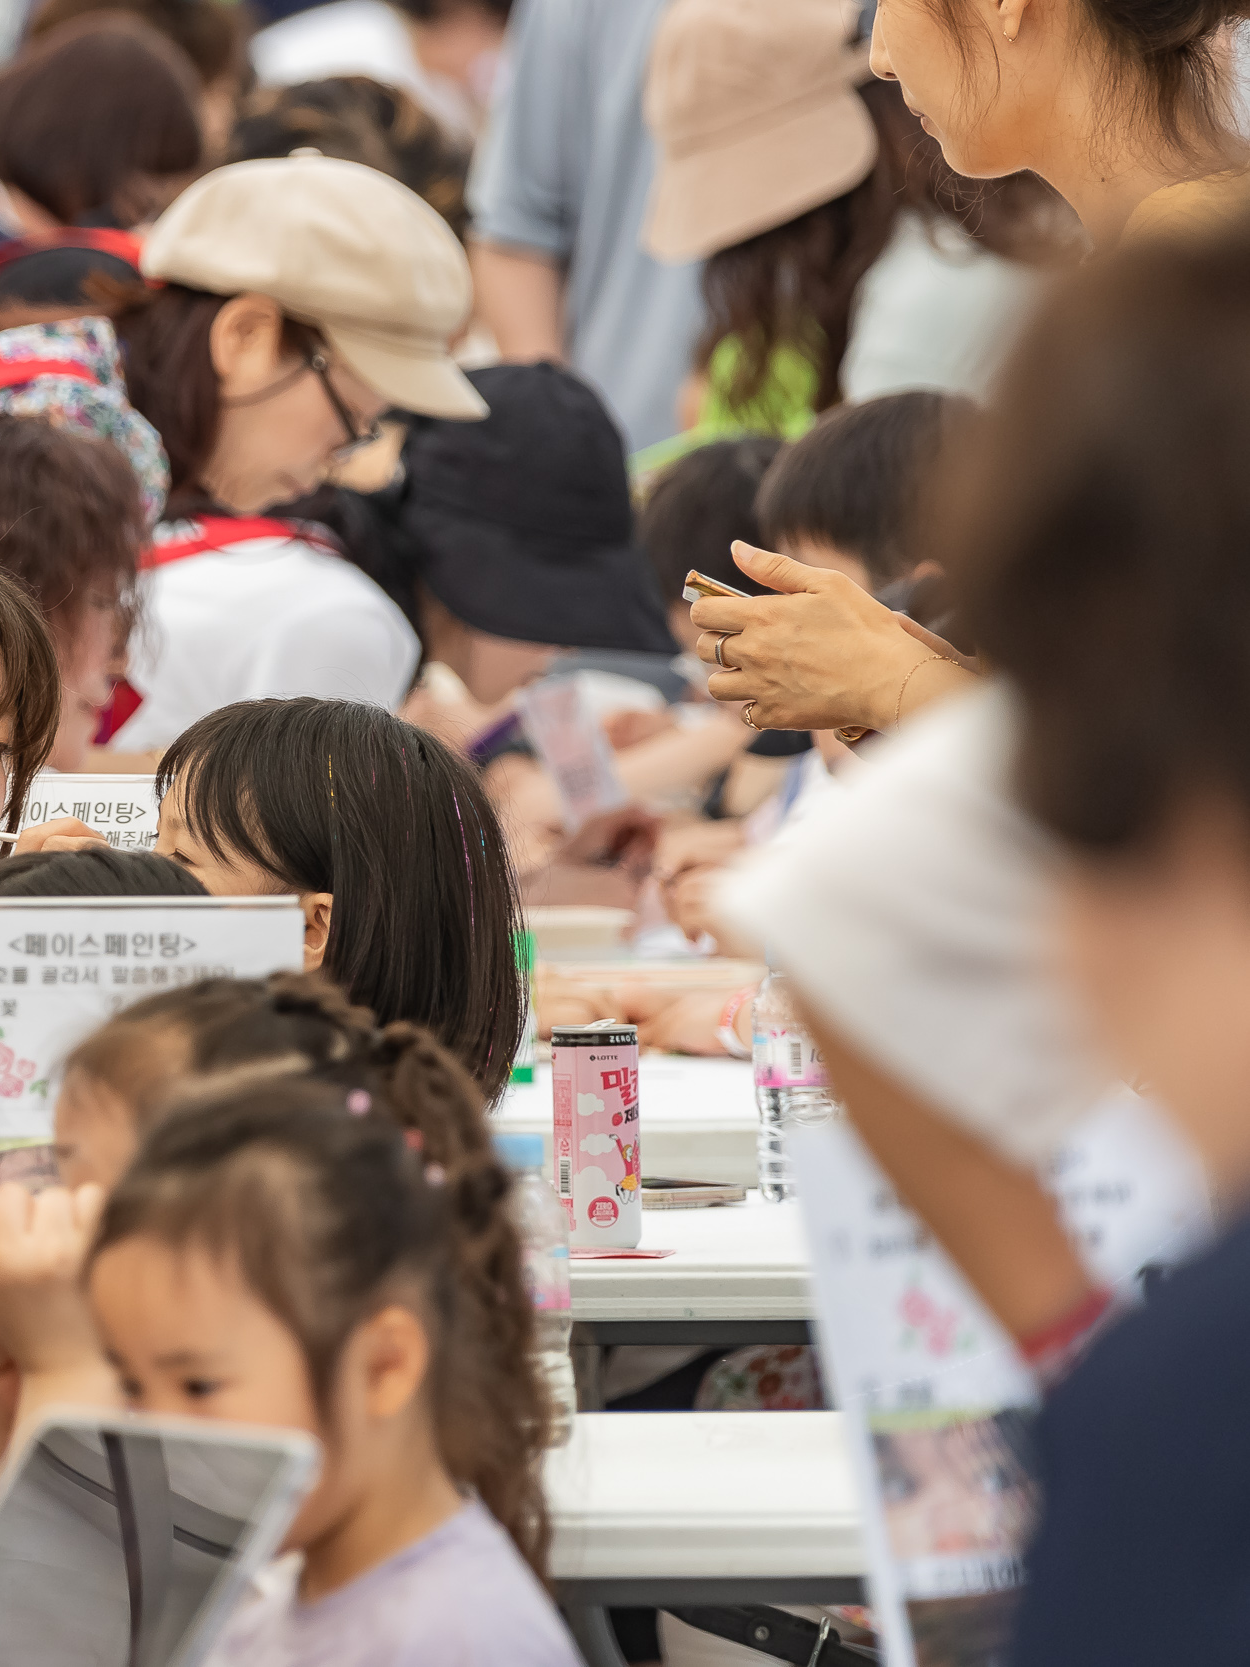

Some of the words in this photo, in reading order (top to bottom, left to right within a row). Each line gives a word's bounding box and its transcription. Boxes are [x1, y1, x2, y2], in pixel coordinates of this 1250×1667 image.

[20, 802, 147, 824] 이스페인팅>
[8, 932, 197, 958] <페이스페인팅>
[41, 966, 99, 985] 골라서
[609, 1035, 630, 1043] ZERO
